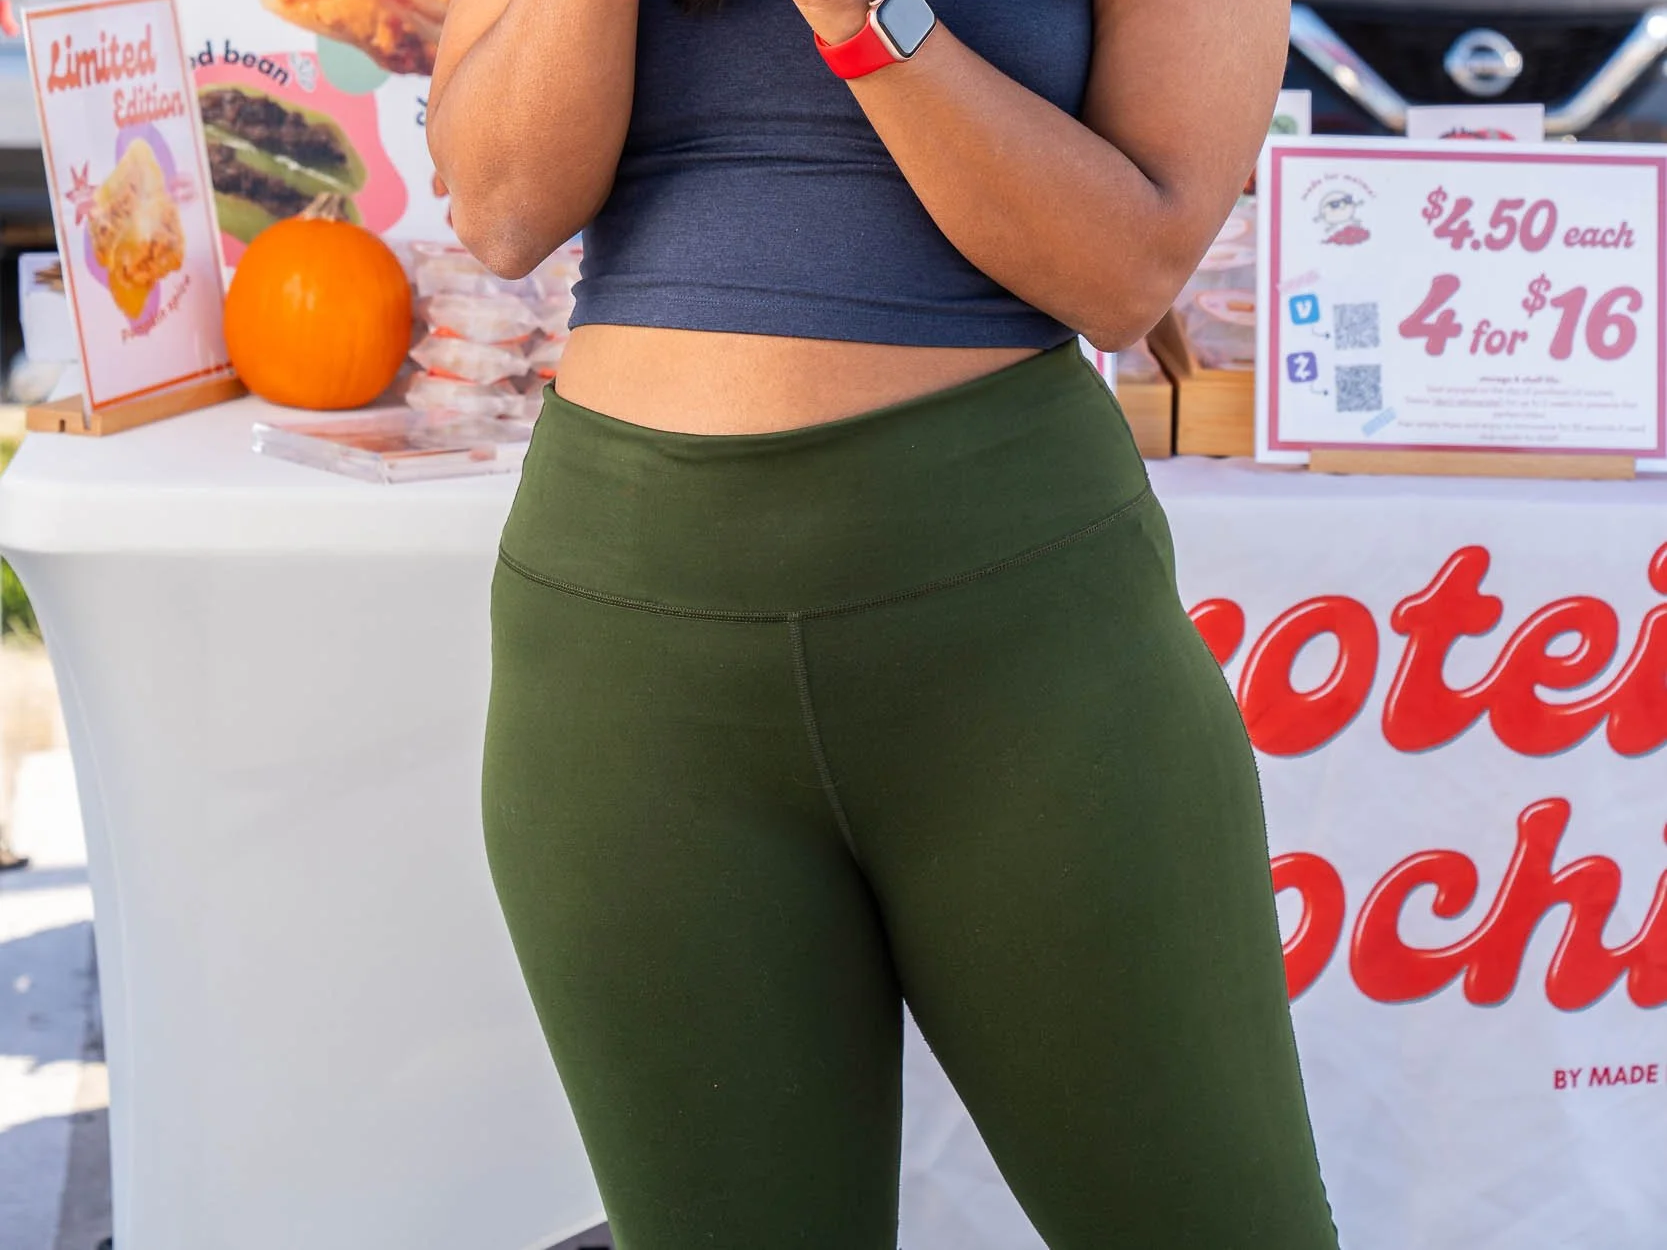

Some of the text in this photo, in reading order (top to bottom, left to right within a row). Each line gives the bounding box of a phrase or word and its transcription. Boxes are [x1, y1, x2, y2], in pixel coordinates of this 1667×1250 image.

[47, 23, 157, 94] Limited
[224, 39, 289, 87] bean
[113, 82, 185, 129] Edition
[1421, 185, 1636, 253] $4.50 each
[1398, 272, 1644, 361] 4 for $16
[1554, 1063, 1659, 1090] BY MADE
